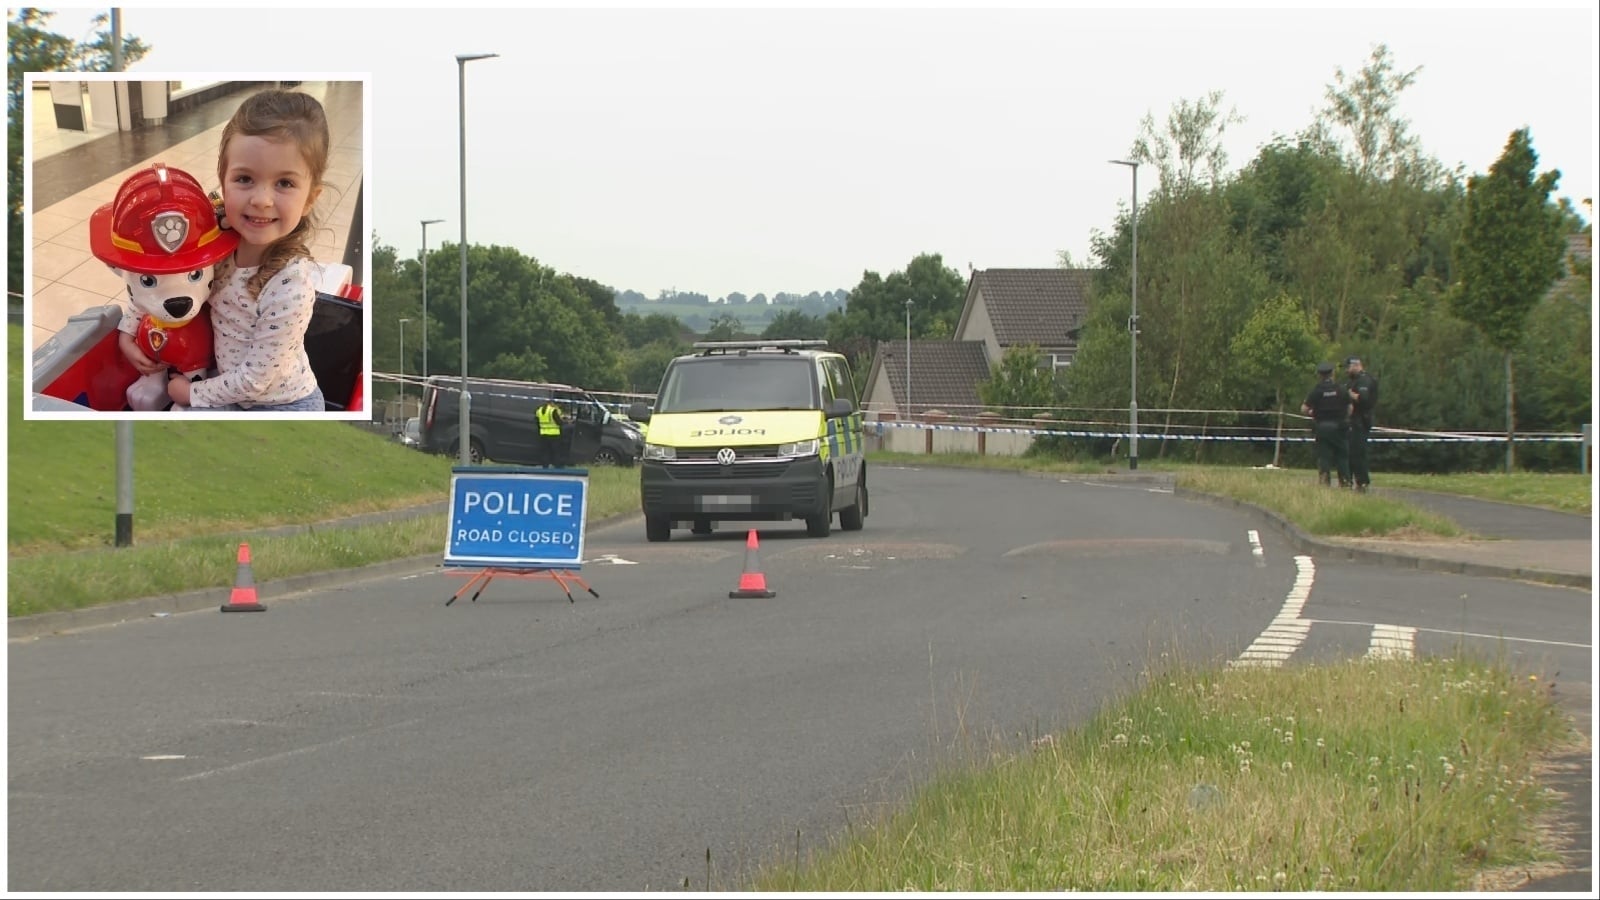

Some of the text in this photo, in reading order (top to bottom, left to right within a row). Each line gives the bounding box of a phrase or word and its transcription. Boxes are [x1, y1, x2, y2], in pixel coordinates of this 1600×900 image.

[464, 491, 573, 516] POLICE
[457, 529, 573, 544] ROAD CLOSED
